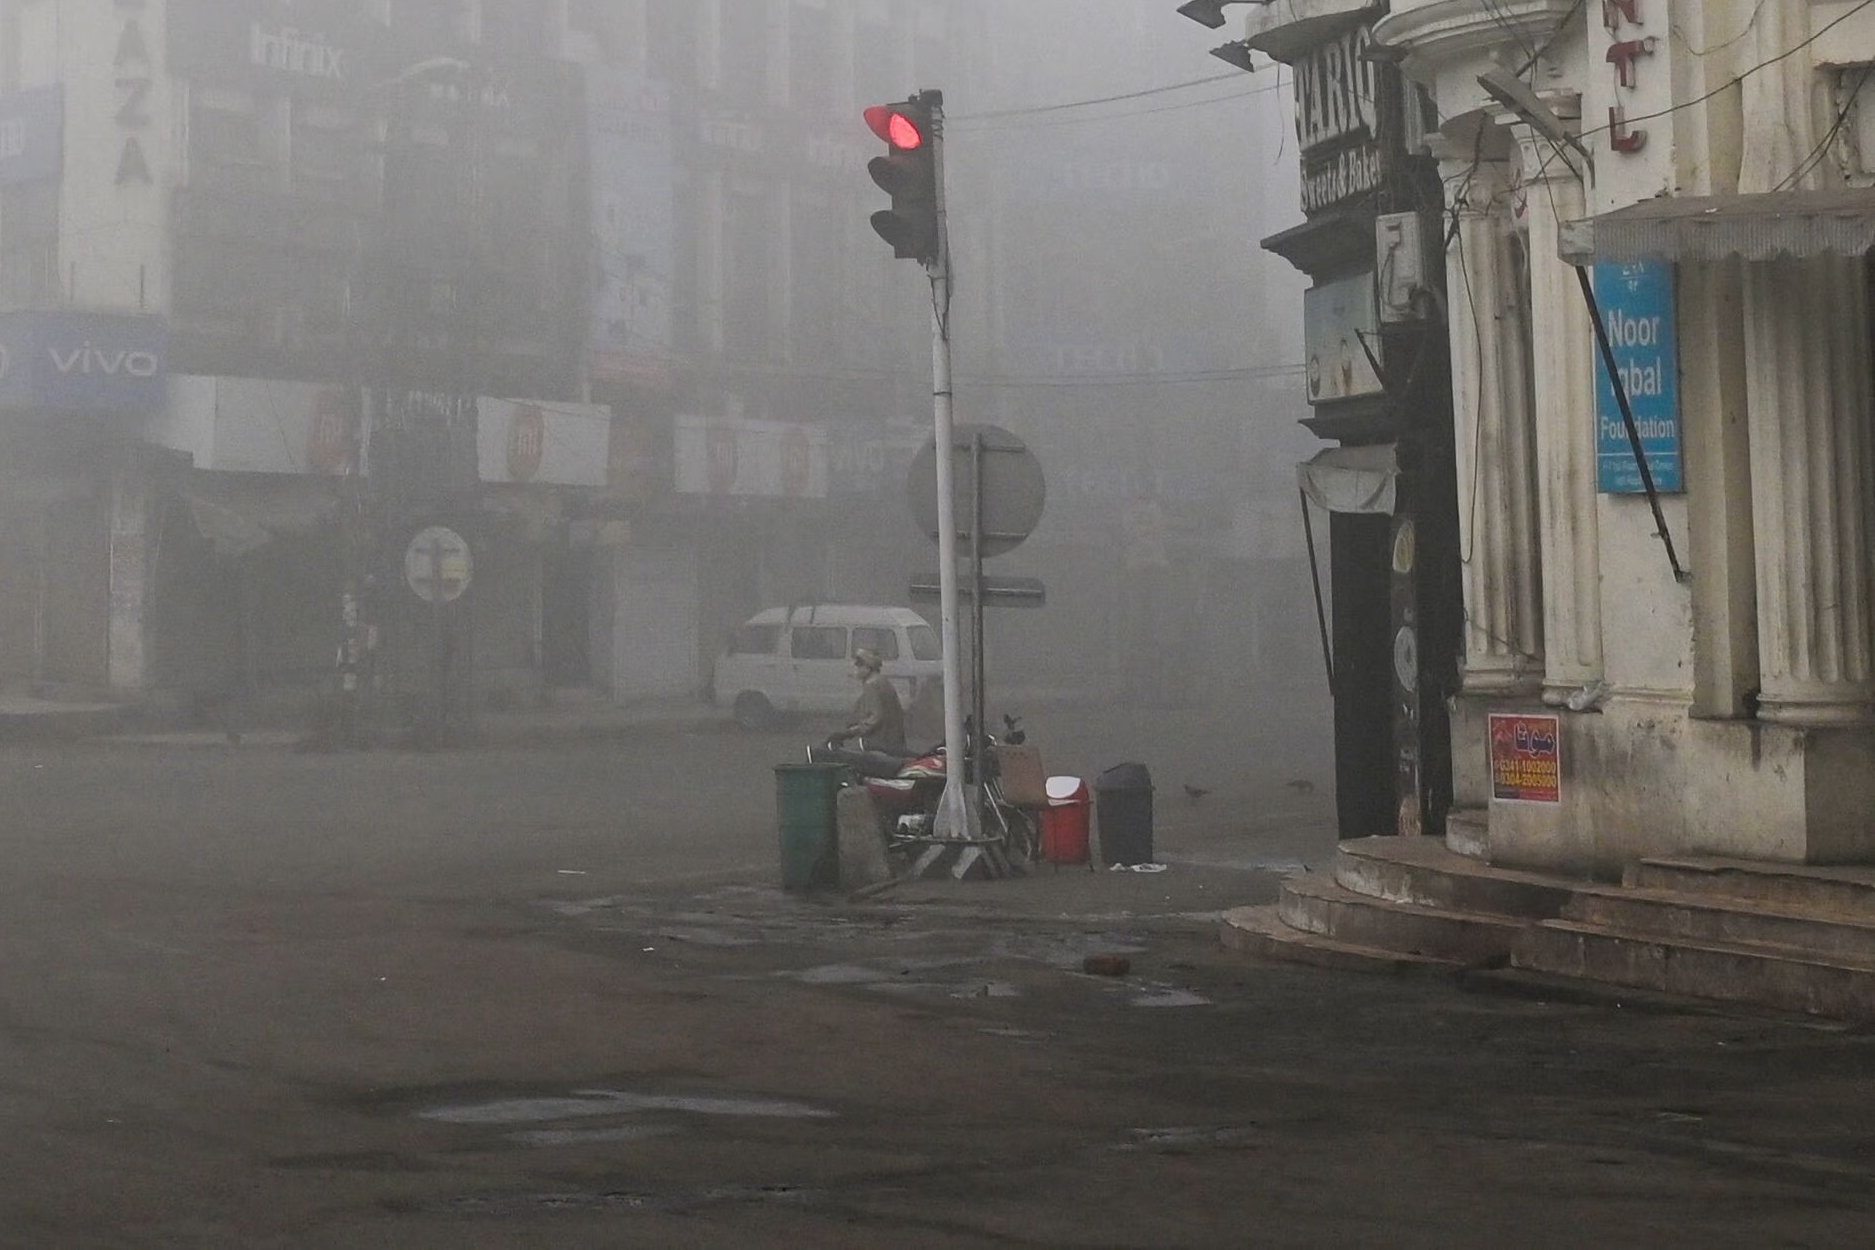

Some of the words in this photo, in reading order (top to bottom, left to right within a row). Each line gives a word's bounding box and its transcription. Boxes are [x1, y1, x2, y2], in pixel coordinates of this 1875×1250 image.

[1608, 309, 1660, 347] Noor
[49, 339, 158, 377] vivo
[1601, 415, 1676, 440] Foudation
